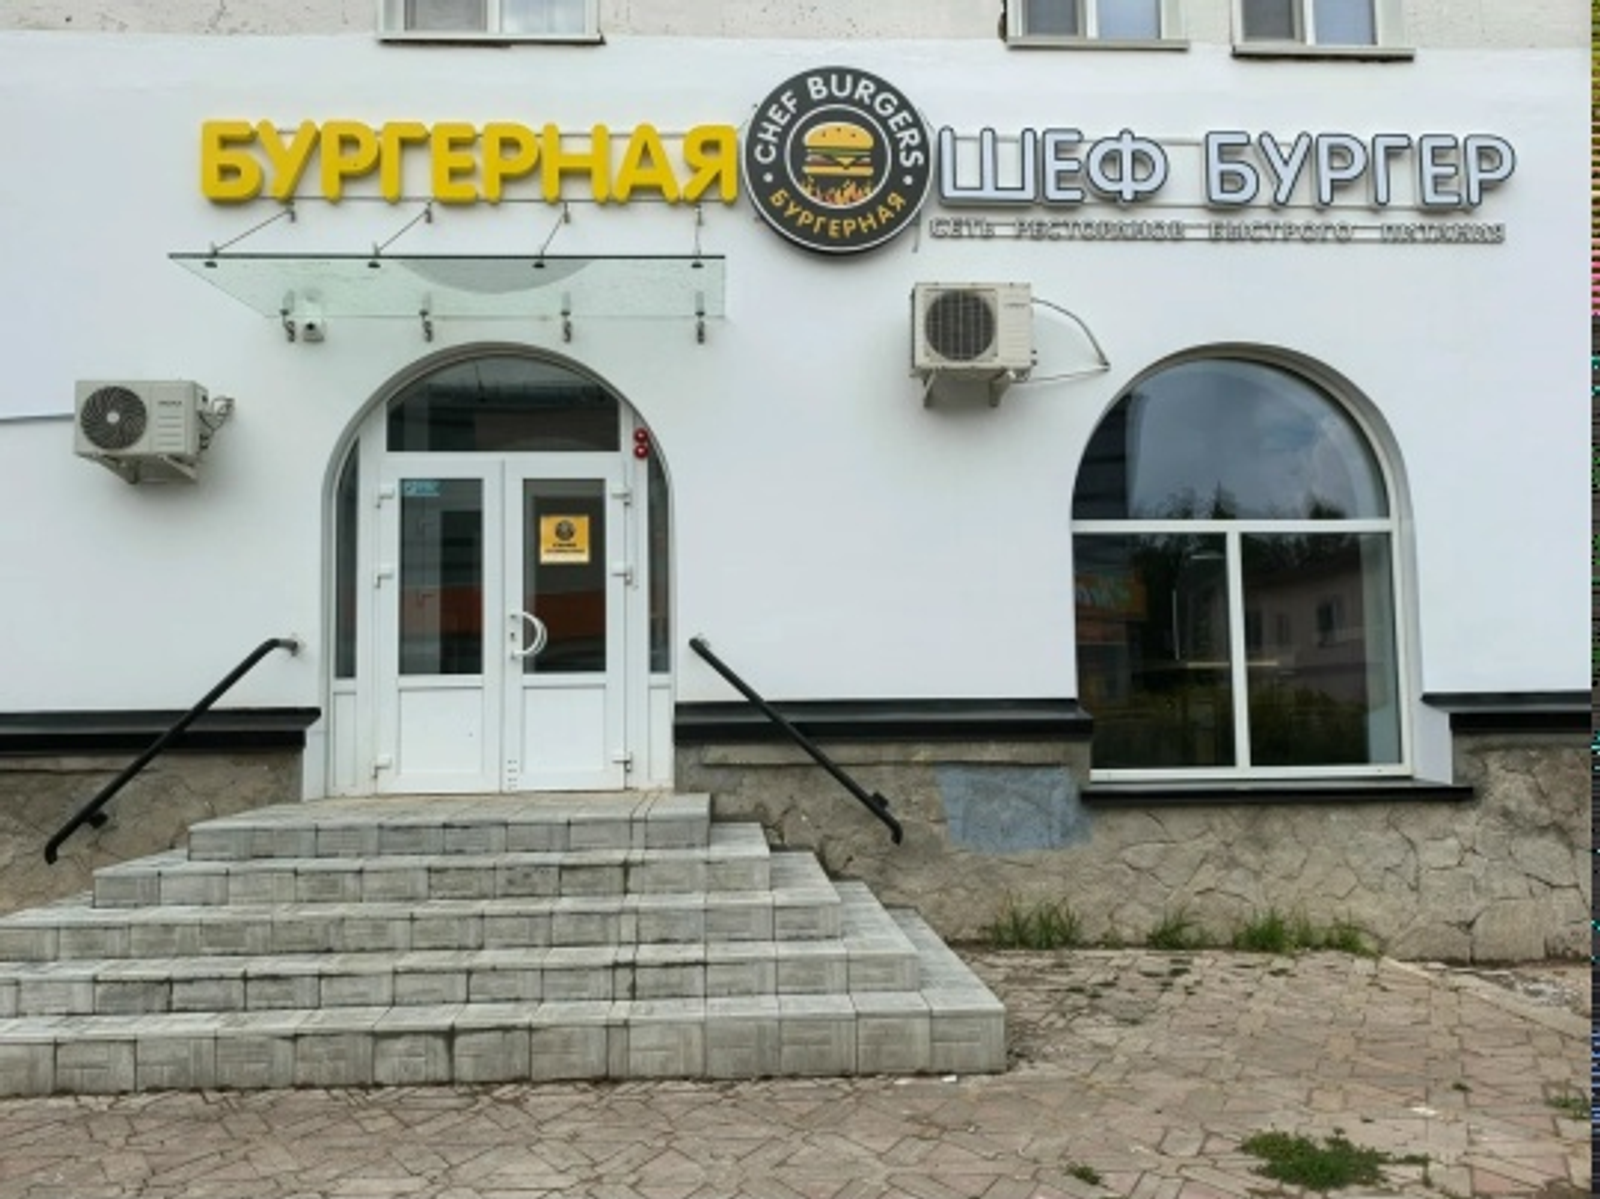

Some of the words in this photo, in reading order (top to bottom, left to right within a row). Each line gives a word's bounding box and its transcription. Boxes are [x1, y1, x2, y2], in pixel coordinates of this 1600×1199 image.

[200, 120, 738, 206] БУРГЕРНАЯ
[754, 89, 799, 164] CHEF
[806, 74, 924, 168] BURGERS
[937, 126, 1169, 206] ШЕФ
[1203, 129, 1516, 212] БУРГЕР
[769, 189, 907, 239] БУРГЕРНАЯ
[929, 219, 995, 240] СЕТЬ
